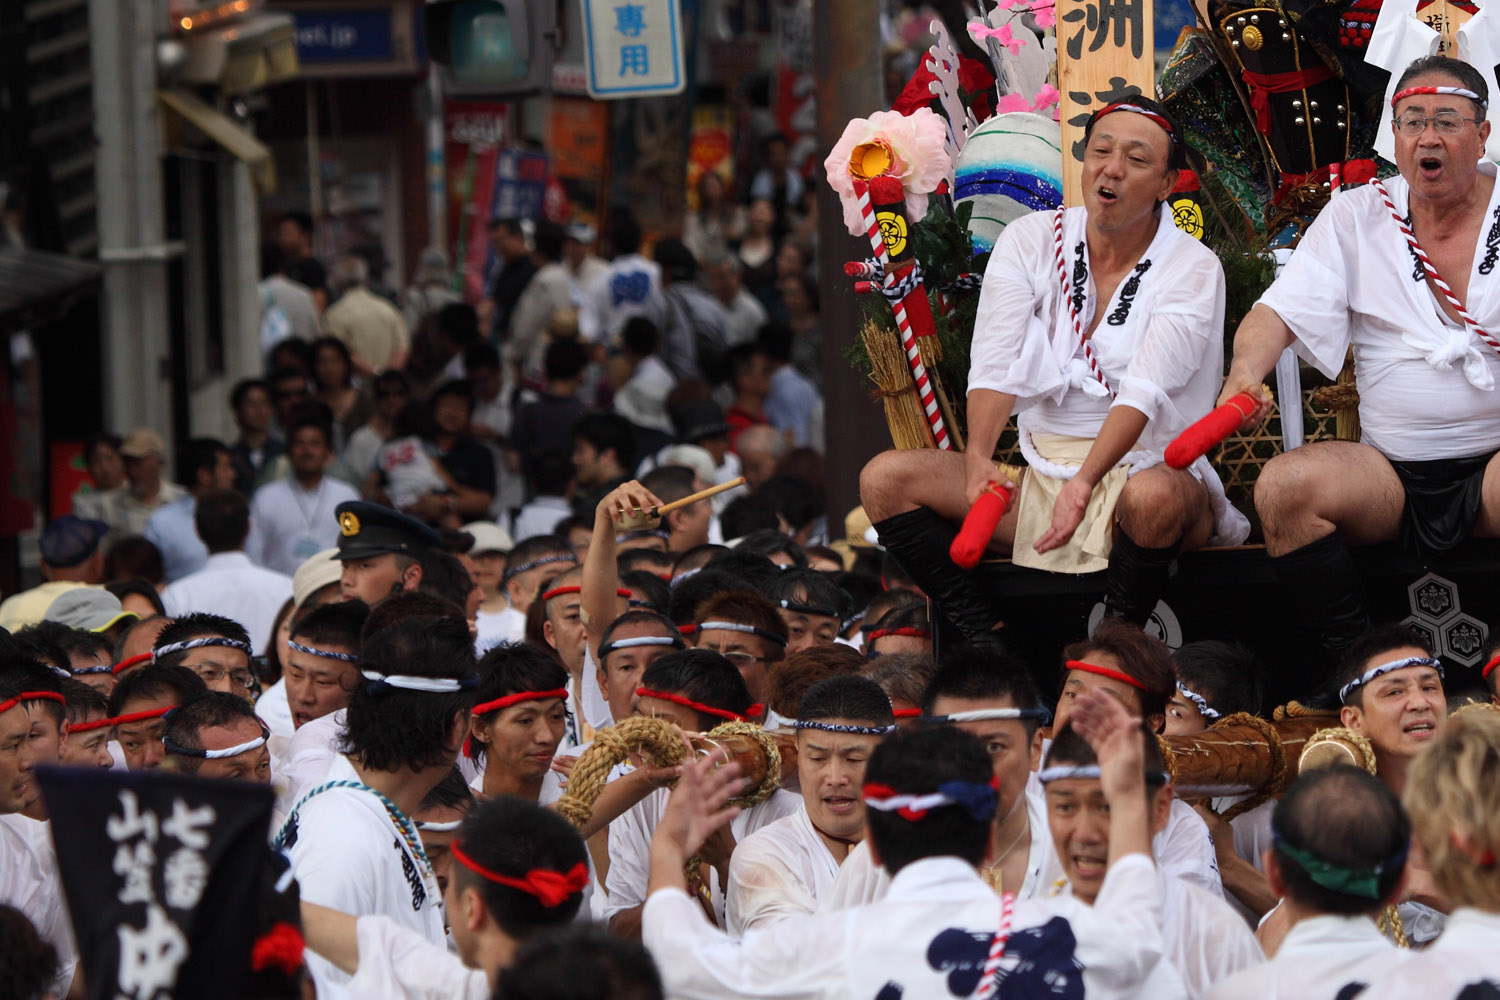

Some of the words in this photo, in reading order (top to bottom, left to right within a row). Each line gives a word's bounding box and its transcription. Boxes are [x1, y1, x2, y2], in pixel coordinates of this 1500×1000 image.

[614, 3, 649, 77] 専用
[106, 788, 160, 906] 山笠
[162, 796, 217, 910] 七番
[113, 903, 190, 1000] 中
